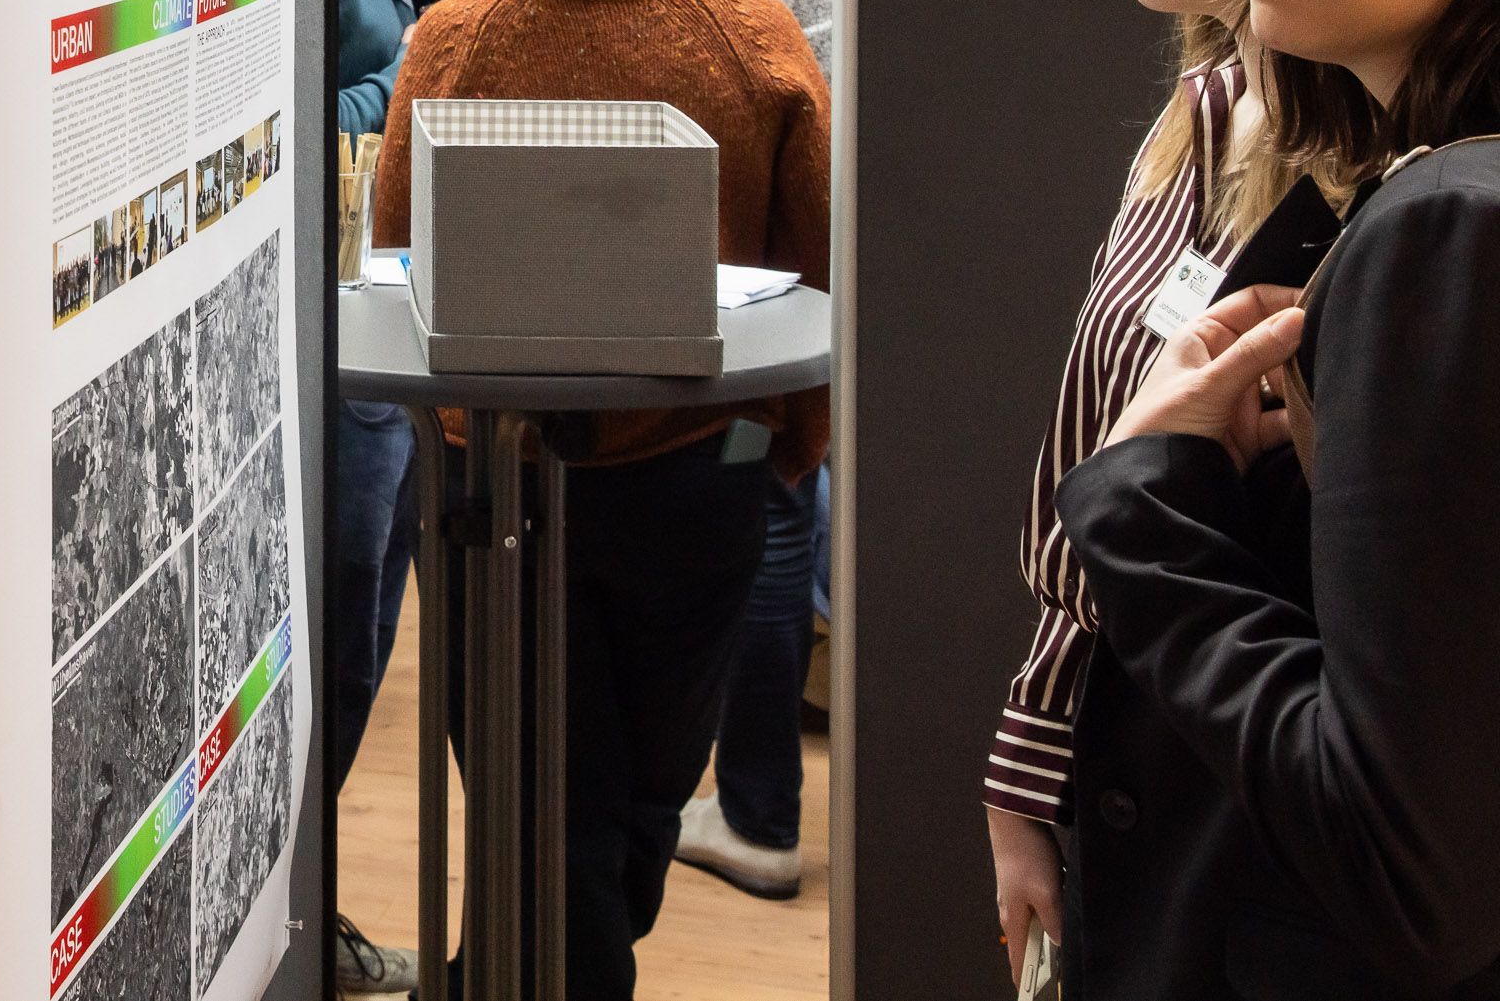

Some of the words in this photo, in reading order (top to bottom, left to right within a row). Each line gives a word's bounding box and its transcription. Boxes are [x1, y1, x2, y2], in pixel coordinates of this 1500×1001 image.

[52, 20, 93, 64] URBAN
[199, 728, 222, 782] CASE
[265, 618, 292, 682] STUDIES
[50, 914, 83, 985] CASE
[153, 766, 196, 844] STUDIES
